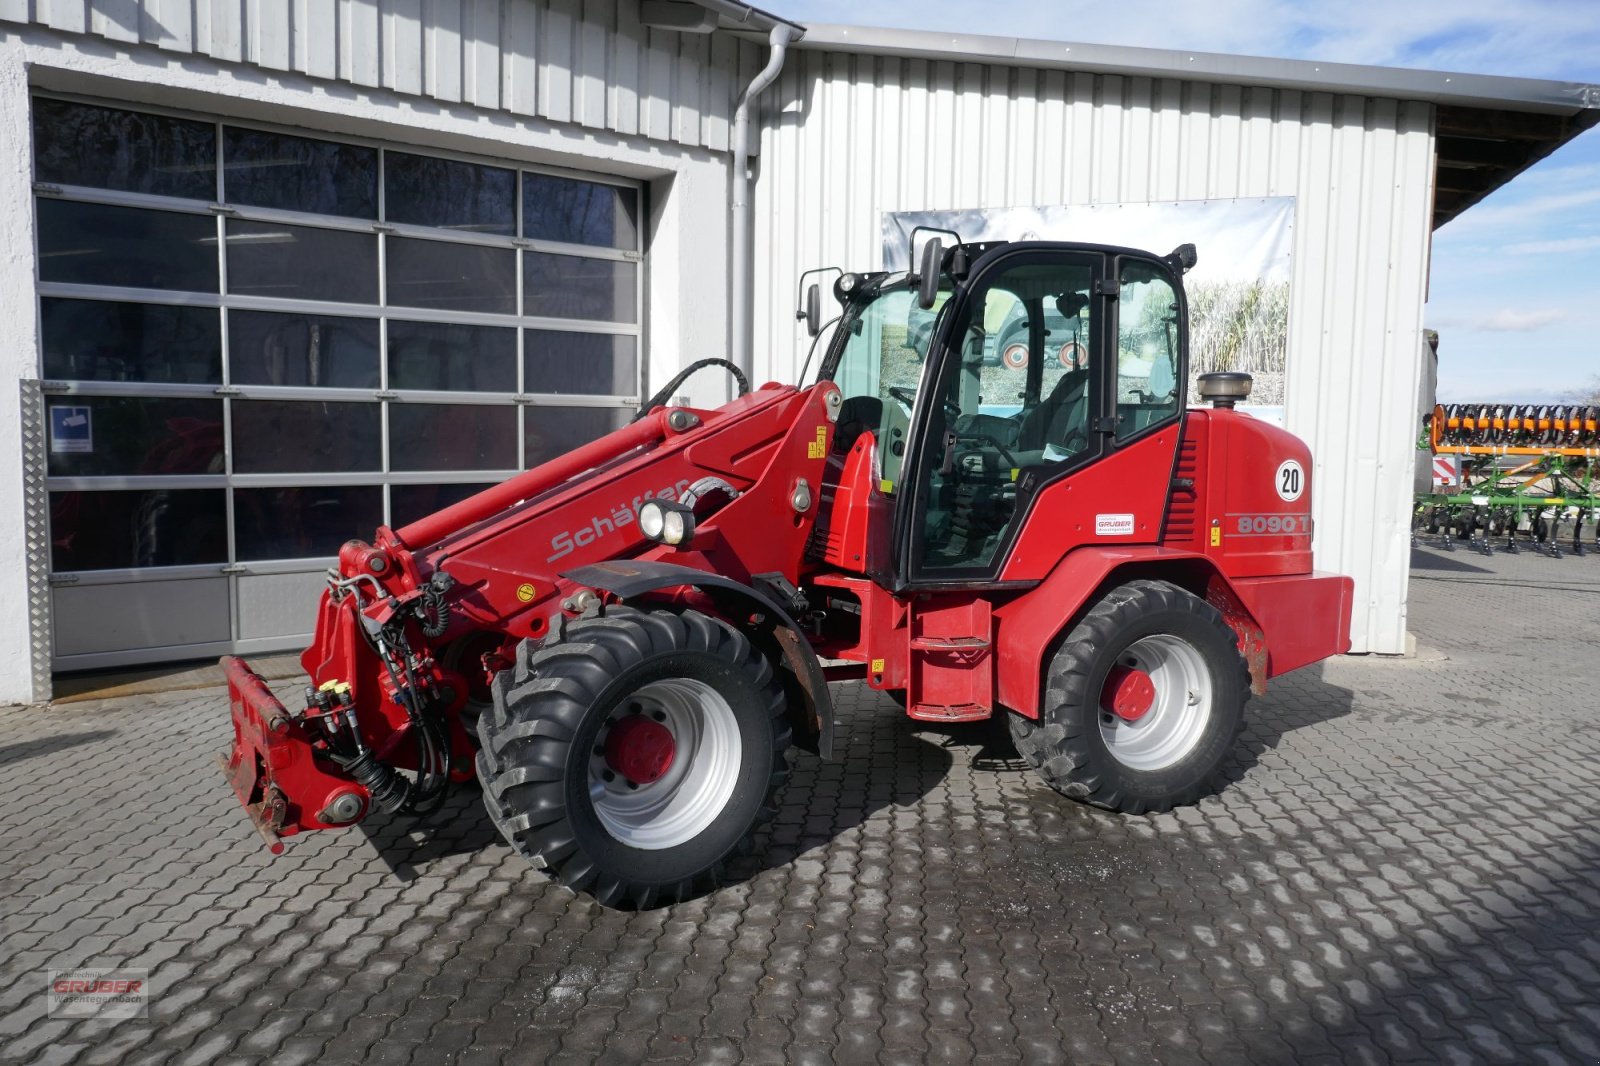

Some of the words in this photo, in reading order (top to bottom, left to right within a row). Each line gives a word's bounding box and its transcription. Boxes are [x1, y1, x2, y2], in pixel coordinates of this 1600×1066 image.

[1282, 468, 1299, 493] 20
[1238, 516, 1296, 533] 8090
[1299, 515, 1310, 533] T
